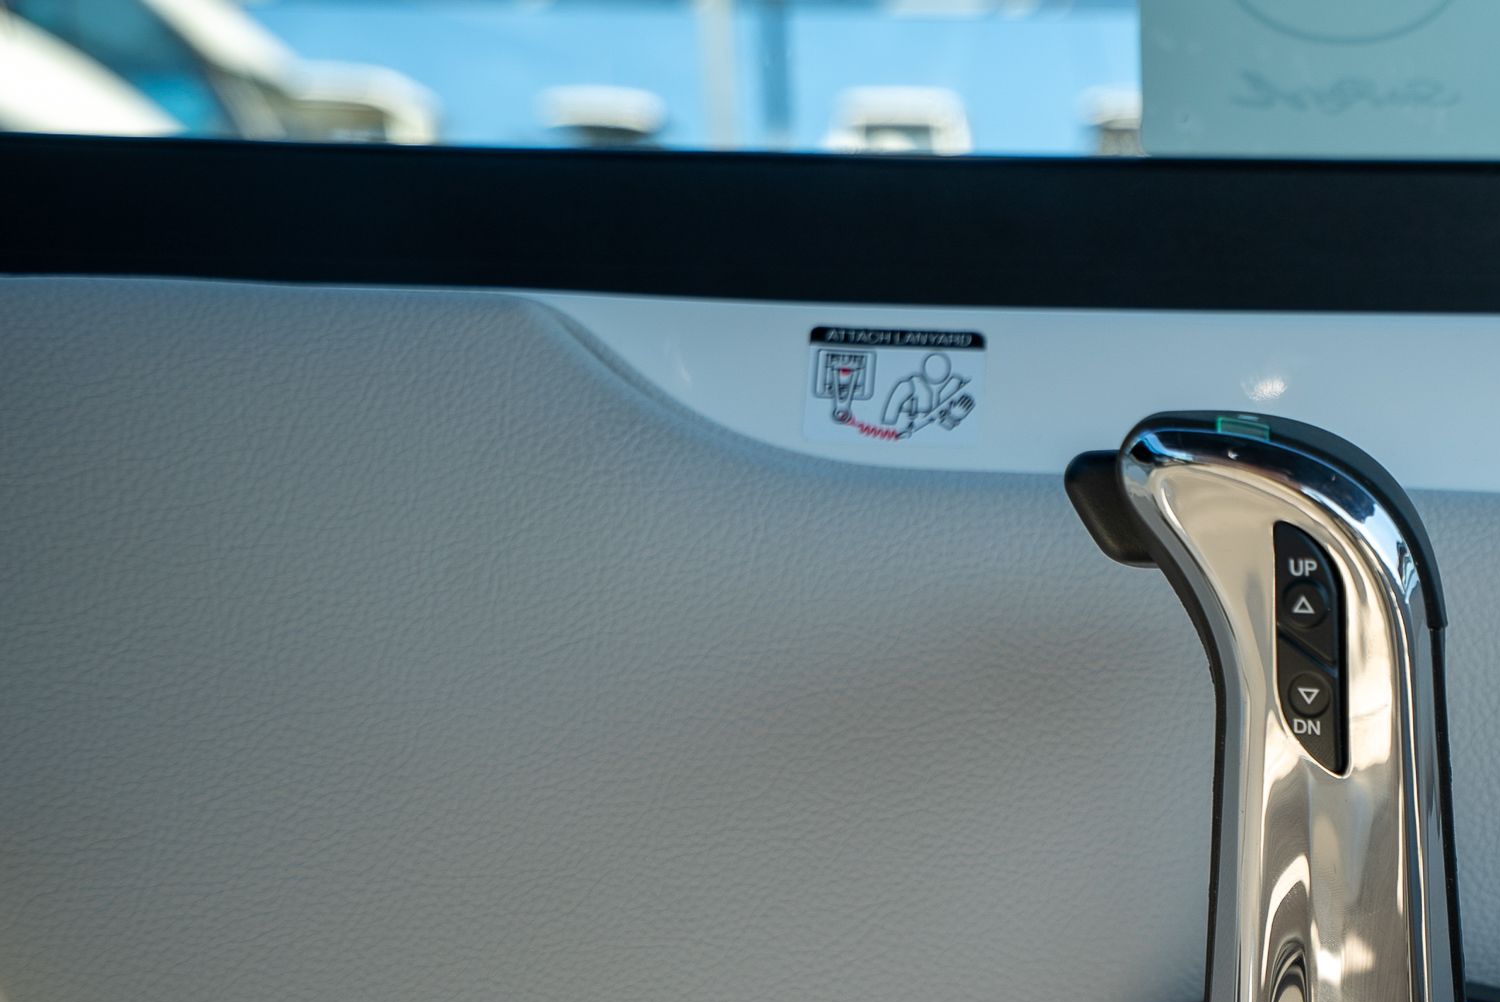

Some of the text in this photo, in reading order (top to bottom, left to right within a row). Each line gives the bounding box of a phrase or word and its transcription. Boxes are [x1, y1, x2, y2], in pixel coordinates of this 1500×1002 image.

[826, 329, 973, 347] ATTACH LANYARD
[1289, 559, 1317, 576] UP
[1293, 719, 1321, 736] DN
